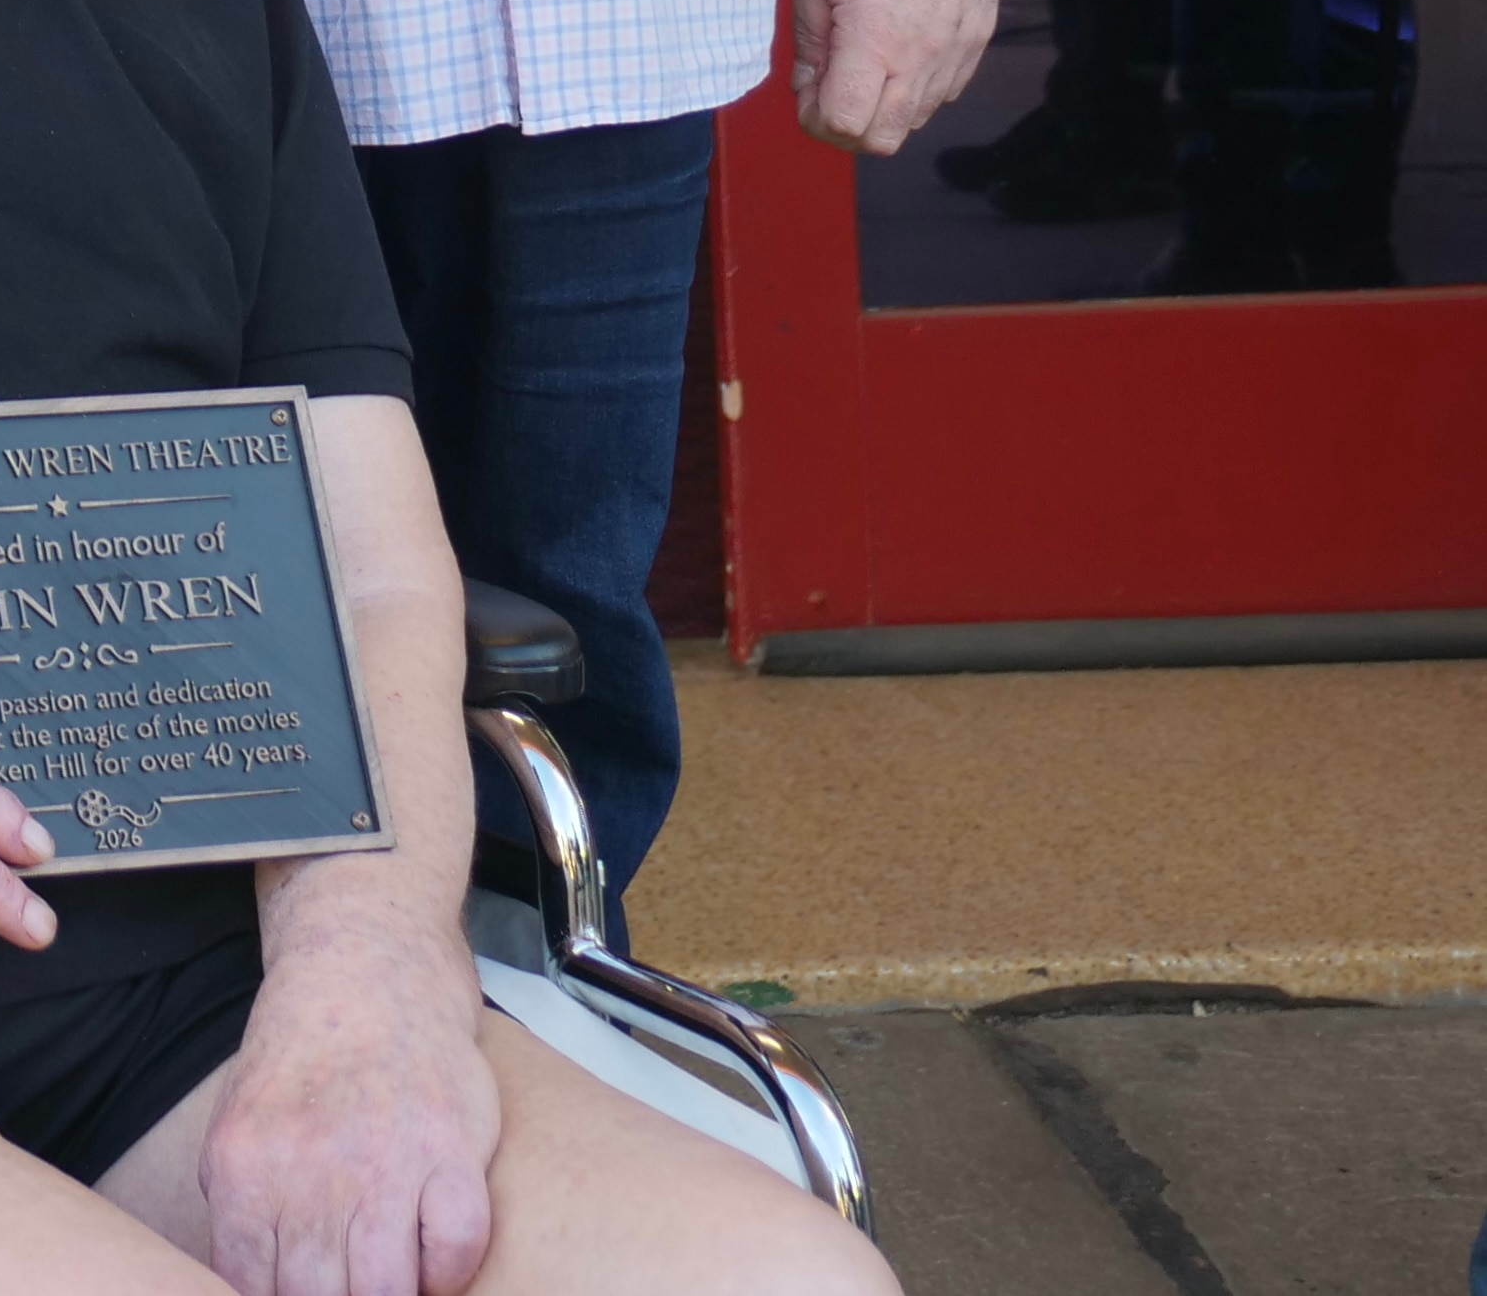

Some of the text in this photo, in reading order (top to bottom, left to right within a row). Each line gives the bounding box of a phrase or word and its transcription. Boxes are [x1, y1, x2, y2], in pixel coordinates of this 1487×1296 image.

[4, 445, 113, 478] WREN
[121, 433, 292, 471] THEATRE
[35, 533, 63, 562] in
[72, 529, 185, 560] honour
[196, 521, 227, 553] of
[75, 573, 264, 626] WREN
[97, 682, 140, 709] and
[147, 676, 272, 706] dedication
[11, 721, 51, 749] the
[59, 720, 129, 750] magic
[137, 713, 161, 740] of
[169, 711, 209, 739] the
[216, 707, 301, 736] movies
[45, 751, 87, 780] Hill
[94, 748, 131, 776] for
[140, 749, 195, 775] over
[203, 741, 235, 768] 40
[241, 741, 313, 774] years.
[93, 828, 145, 852] 2026
